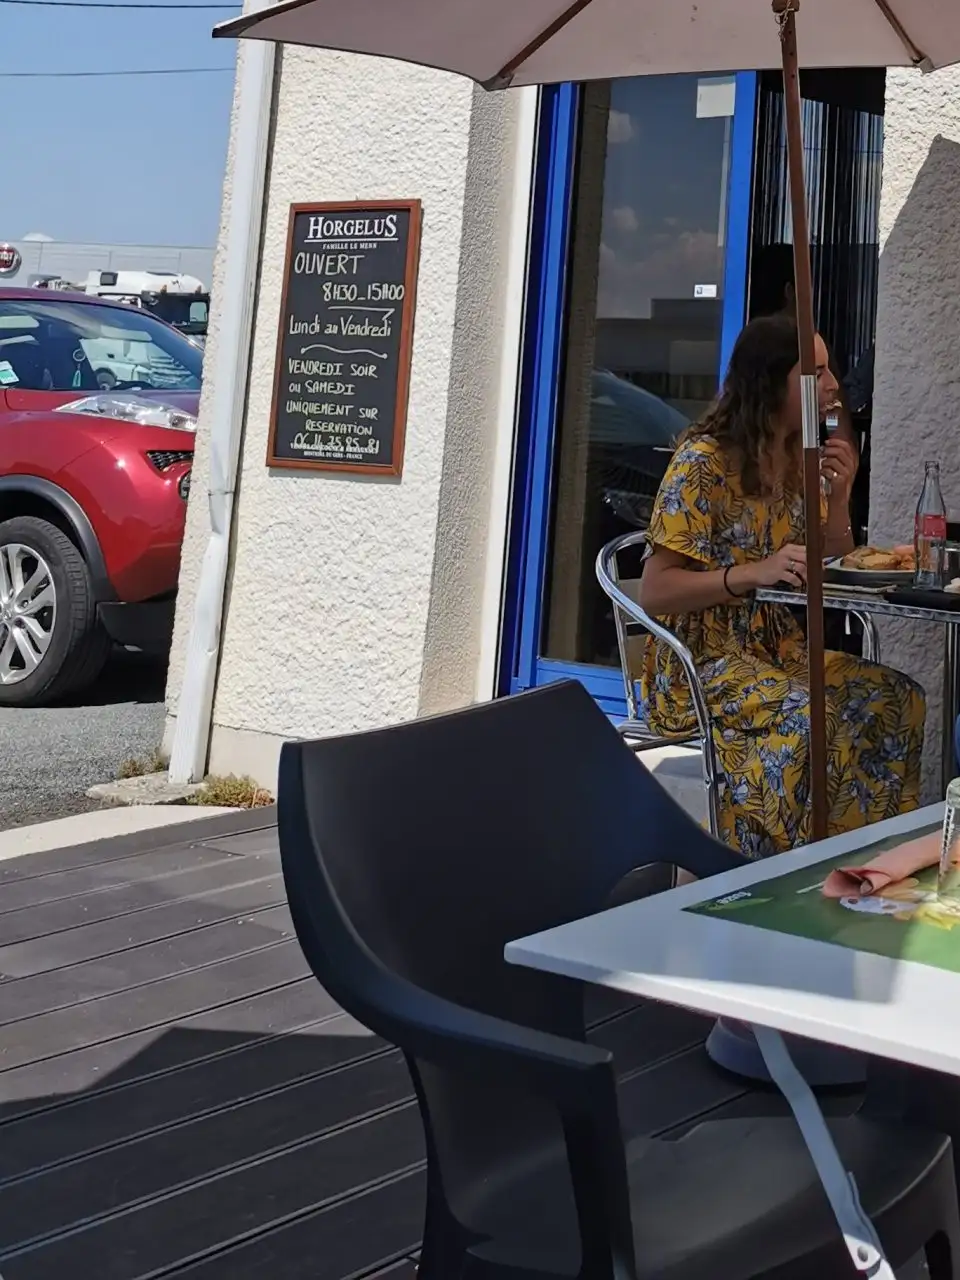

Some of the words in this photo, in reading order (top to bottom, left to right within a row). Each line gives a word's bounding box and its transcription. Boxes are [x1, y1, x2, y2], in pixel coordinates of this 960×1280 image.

[294, 252, 365, 275] OUVERT
[289, 313, 320, 335] Lundi
[324, 323, 338, 334] au
[340, 314, 392, 337] Vendredi
[288, 358, 344, 376] VENDREDI
[305, 379, 355, 395] SAMEDI
[358, 407, 378, 420] SUR
